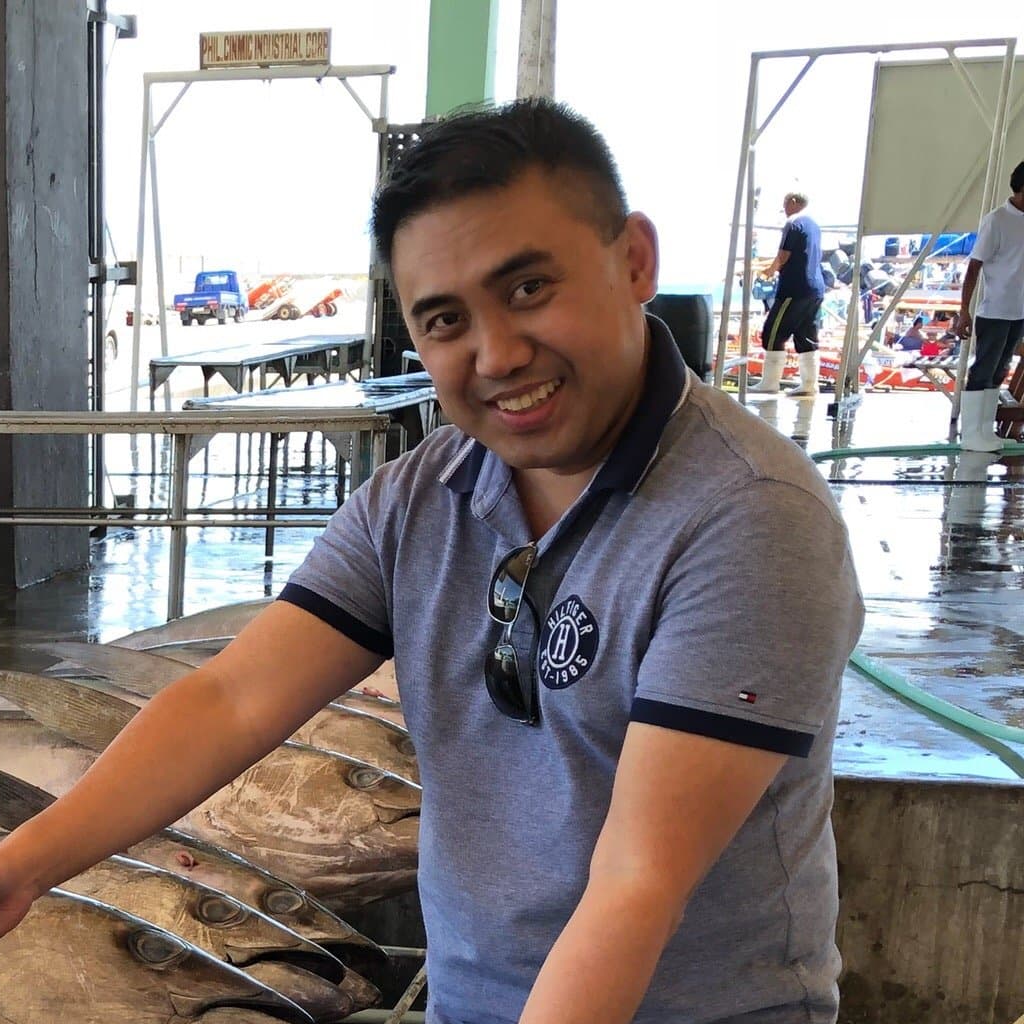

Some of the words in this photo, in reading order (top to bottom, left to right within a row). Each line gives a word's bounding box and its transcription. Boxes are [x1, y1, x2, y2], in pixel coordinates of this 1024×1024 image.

[254, 32, 303, 59] INDUSTRIAL
[547, 600, 594, 636] HILFIGER
[551, 623, 571, 661] H
